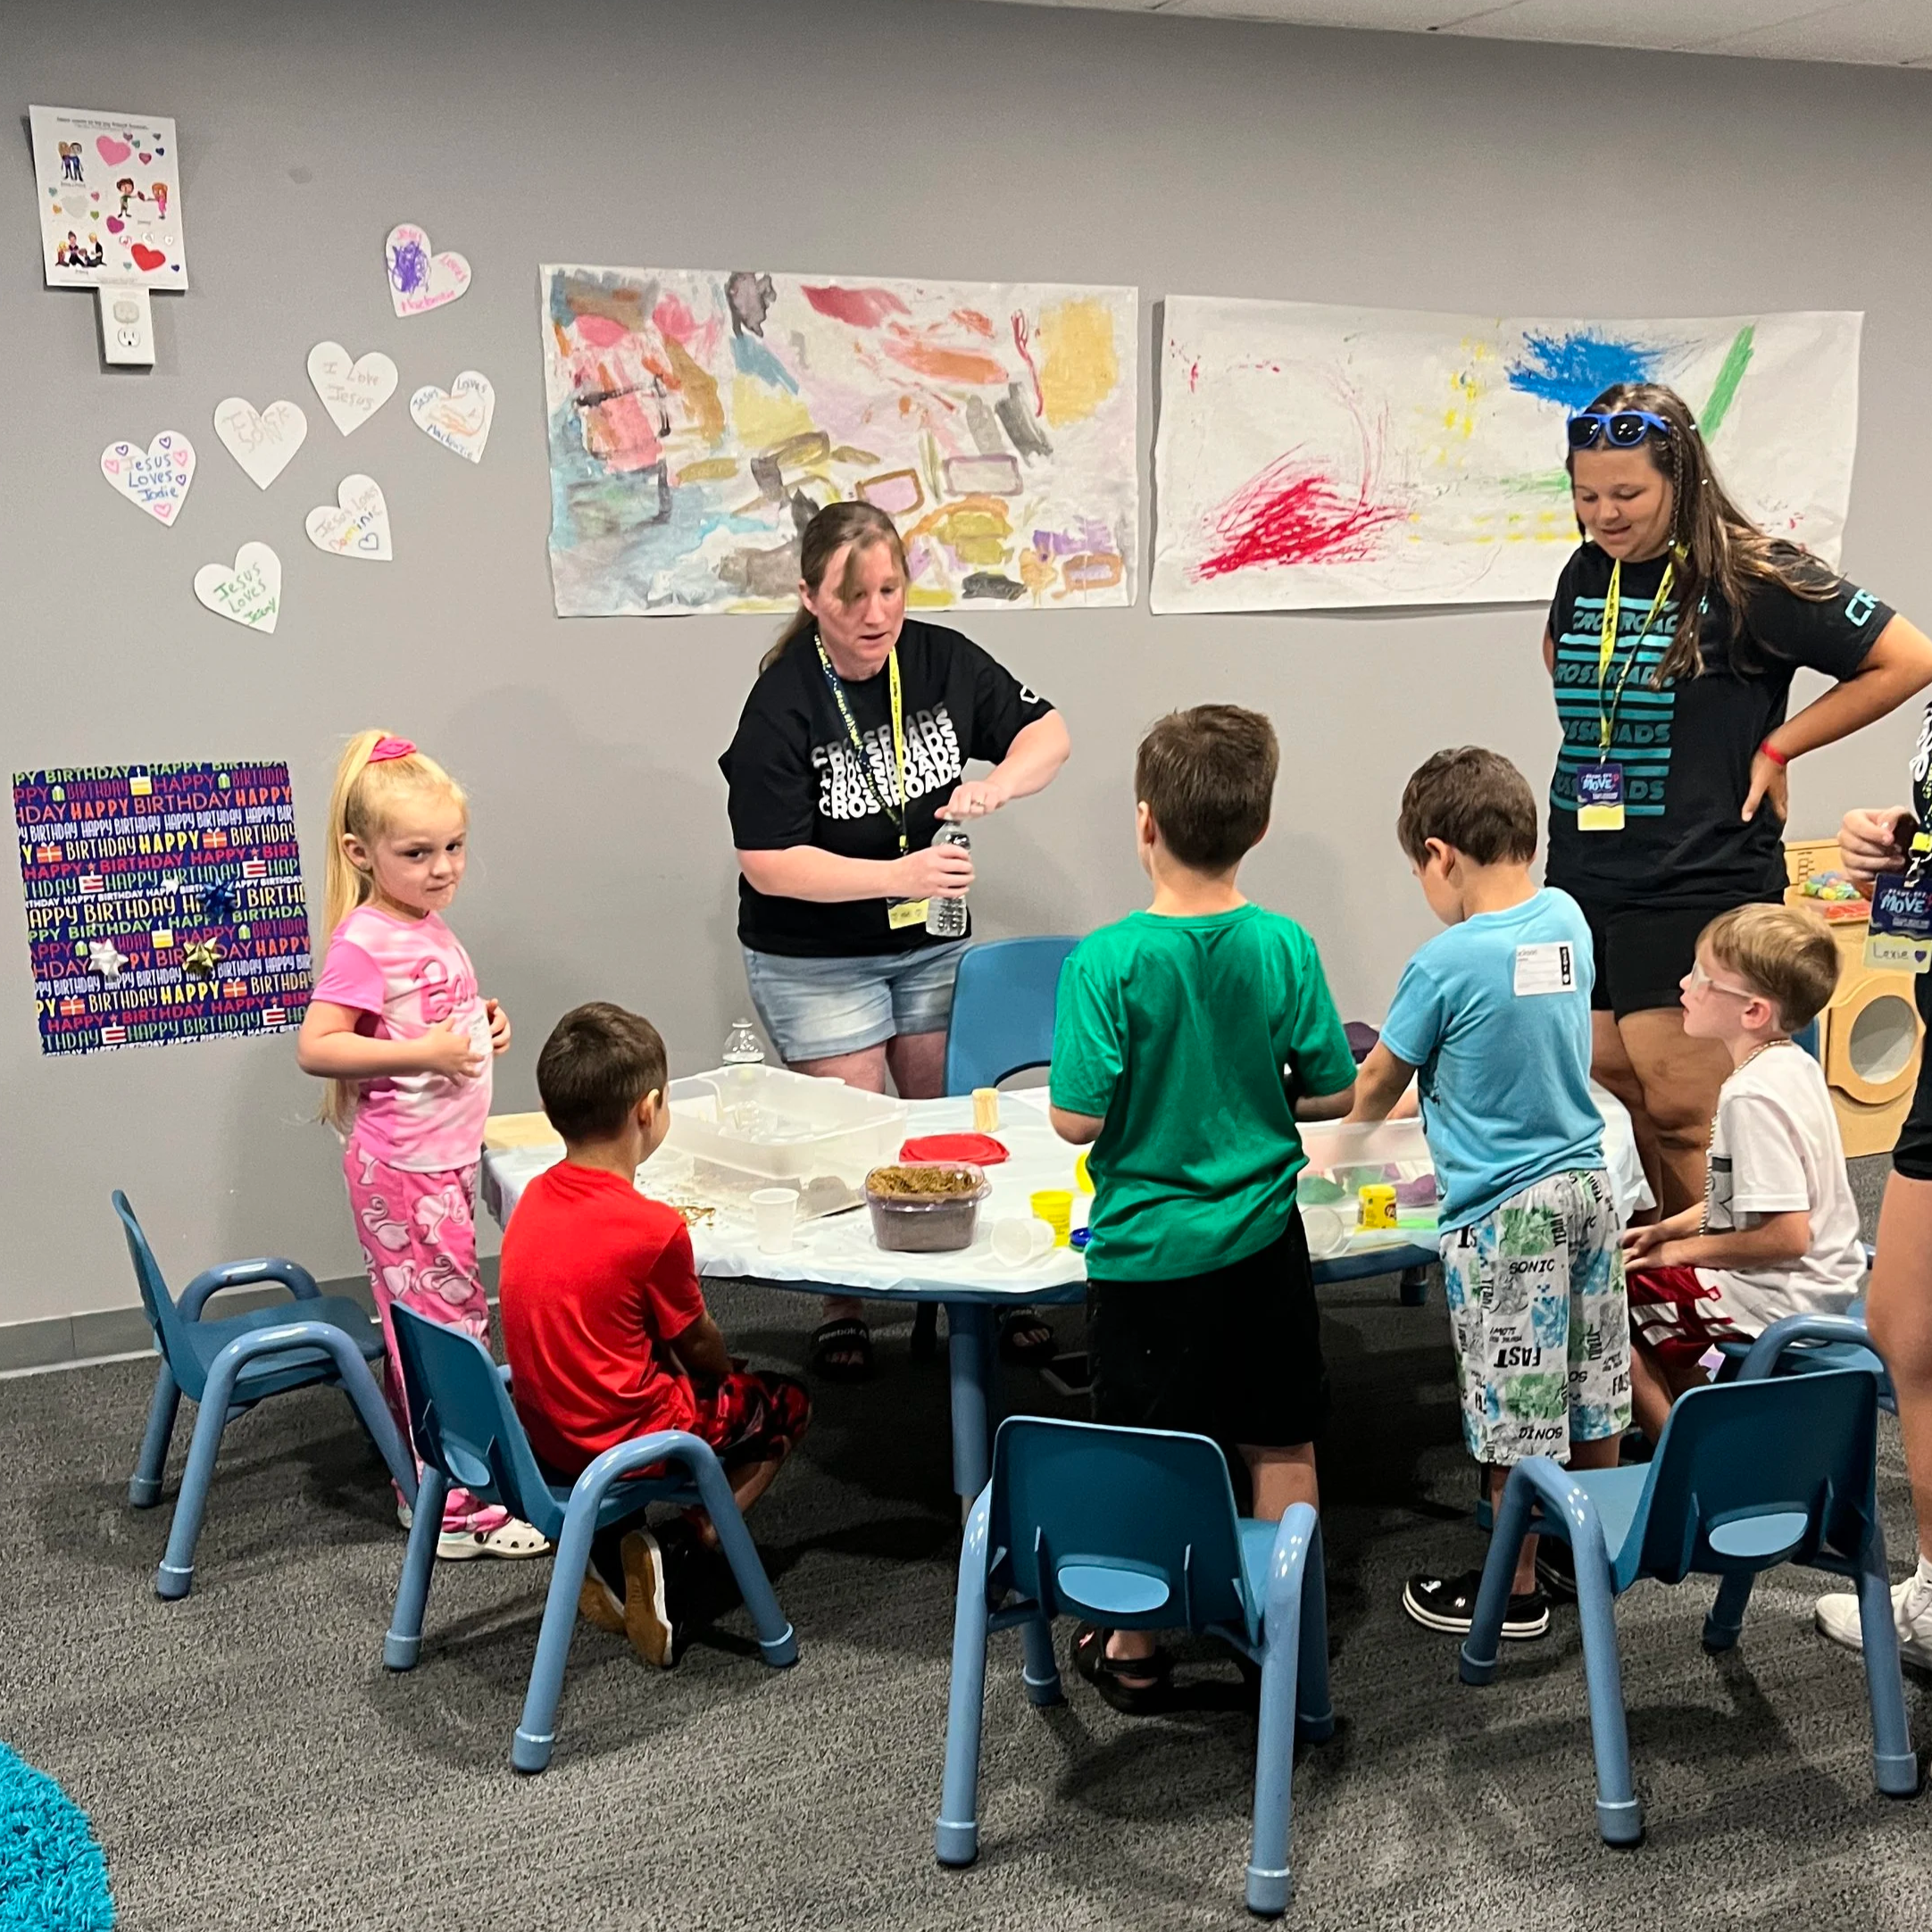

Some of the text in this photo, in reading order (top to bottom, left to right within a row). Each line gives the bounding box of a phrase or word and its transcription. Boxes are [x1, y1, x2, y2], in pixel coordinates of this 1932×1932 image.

[121, 453, 172, 472] Jesus
[129, 471, 173, 488] Loves
[137, 486, 179, 503] Jodie
[212, 562, 262, 603] Jesus
[229, 578, 267, 614] Loves
[154, 774, 214, 794] HAPPY
[71, 799, 129, 820] HAPPY
[135, 791, 232, 815] BIRTHDAY
[235, 786, 292, 807] HAPPY
[30, 821, 78, 843] BIRTHDAY
[81, 819, 112, 838] HAPPY
[114, 814, 161, 836] BIRTHDAY
[164, 812, 195, 832] HAPPY
[196, 807, 242, 829] BIRTHDAY
[246, 805, 276, 824] HAPPY
[66, 836, 137, 861] BIRTHDAY
[138, 829, 199, 854] HAPPY
[230, 822, 297, 847] BIRTHDAY
[24, 862, 83, 880] HAPPY
[100, 852, 184, 874] BIRTHDAY
[190, 847, 246, 865] HAPPY
[63, 895, 96, 905] HAPPY
[98, 889, 143, 902] BIRTHDAY
[261, 875, 303, 887] BIRTHDAY
[105, 870, 159, 892] HAPPY
[84, 896, 176, 923] BIRTHDAY
[1880, 895, 1926, 914] MOVE
[69, 919, 153, 938] BIRTHDAY
[255, 936, 311, 957] HAPPY
[54, 976, 100, 996] BIRTHDAY
[137, 966, 182, 987] BIRTHDAY
[218, 959, 262, 979] BIRTHDAY
[265, 956, 295, 975] HAPPY
[88, 987, 158, 1013] BIRTHDAY
[161, 980, 220, 1005] HAPPY
[47, 1014, 104, 1033] HAPPY
[122, 1004, 204, 1025] BIRTHDAY
[211, 997, 266, 1015] HAPPY
[127, 1020, 179, 1045] HAPPY
[183, 1010, 260, 1036] BIRTHDAY
[1509, 1259, 1555, 1275] SONIC
[818, 1328, 857, 1343] Reebok
[1494, 1346, 1542, 1369] FAST
